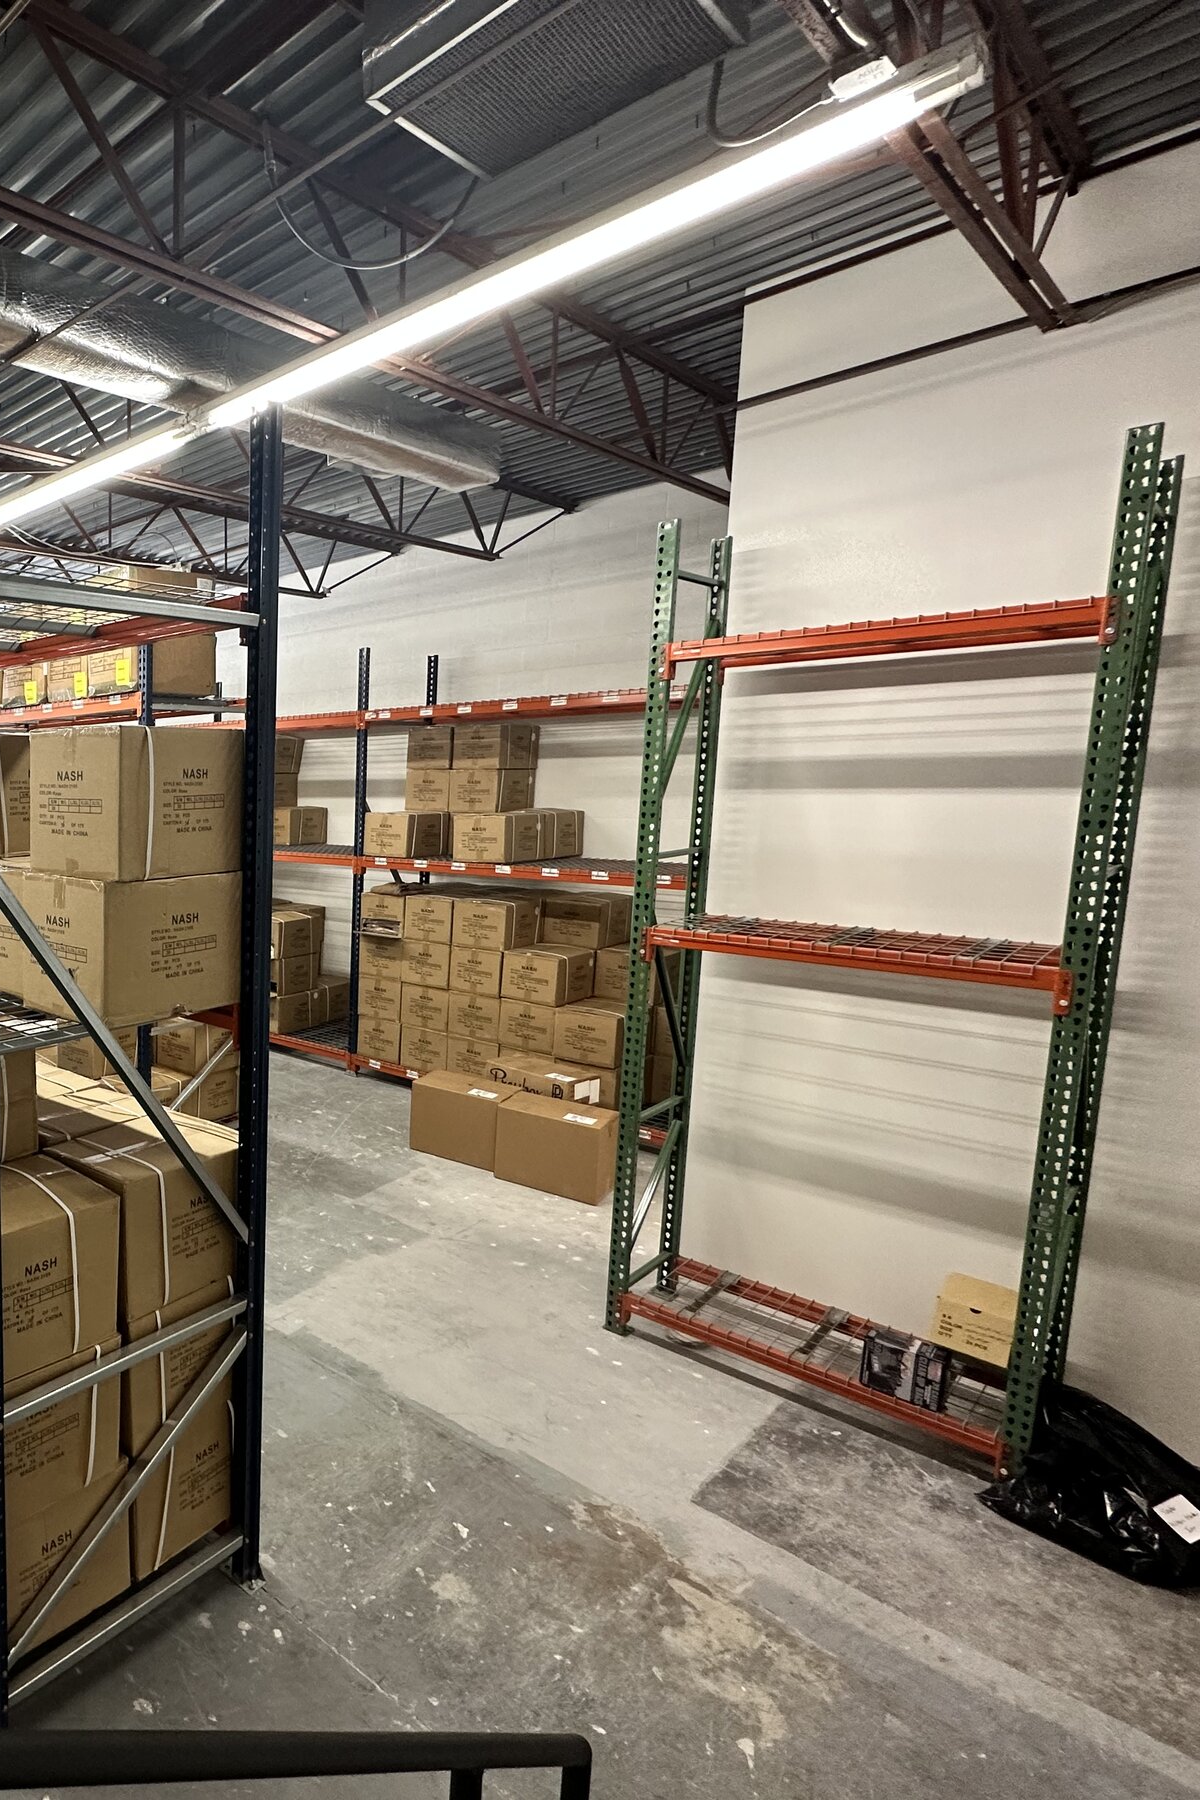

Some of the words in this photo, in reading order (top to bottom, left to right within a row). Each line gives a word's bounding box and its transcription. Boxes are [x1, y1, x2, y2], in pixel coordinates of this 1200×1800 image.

[57, 771, 83, 782] NASH
[182, 768, 208, 779] NASH
[198, 825, 212, 833] CHINA
[46, 914, 70, 928] NASH
[172, 912, 199, 925] NASH
[188, 968, 204, 976] CHINA
[25, 1256, 57, 1277] NASH
[196, 1440, 219, 1463] NASH
[42, 1529, 72, 1556] NASH
